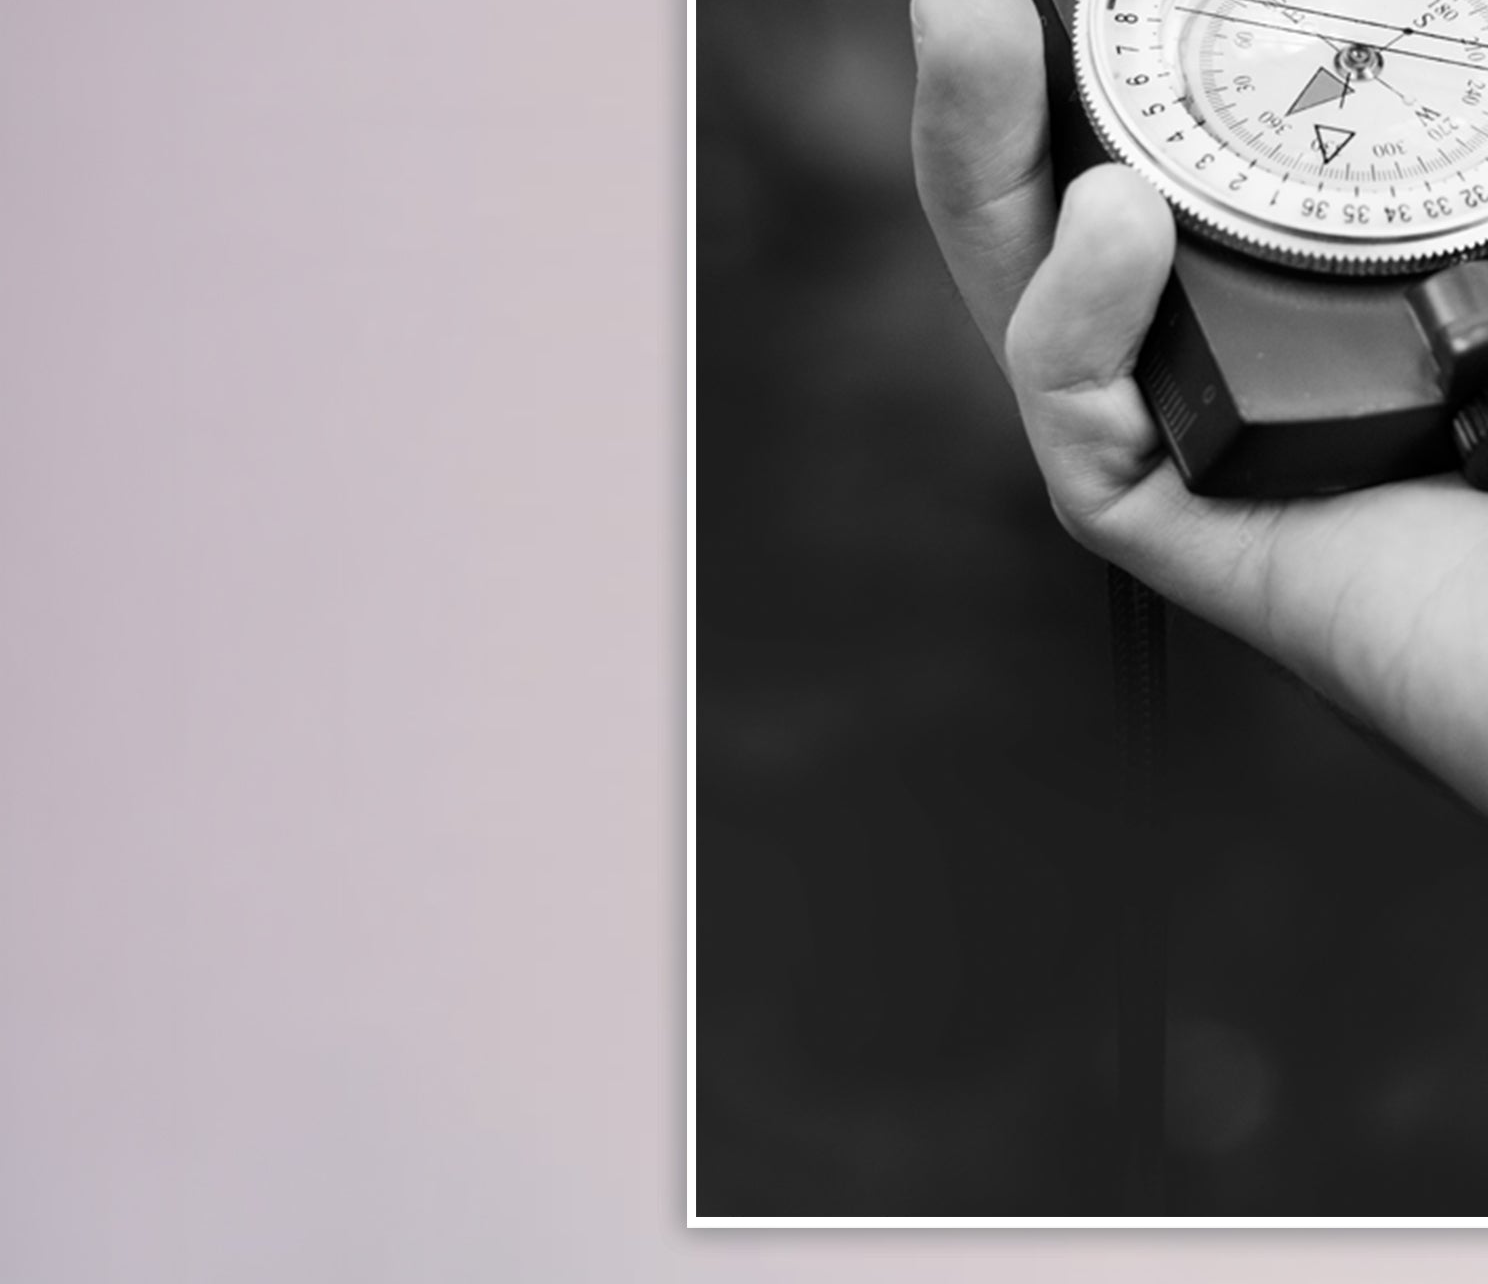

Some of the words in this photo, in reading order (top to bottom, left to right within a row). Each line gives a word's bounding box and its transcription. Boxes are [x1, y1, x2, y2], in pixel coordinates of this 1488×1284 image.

[1114, 13, 1139, 25] 8
[1115, 44, 1140, 56] 7
[1462, 79, 1486, 106] 240
[1141, 102, 1165, 117] 5
[1414, 105, 1442, 127] W
[1165, 131, 1184, 143] 4
[1195, 153, 1216, 170] 3
[1228, 172, 1248, 192] 2
[1269, 189, 1280, 206] 1
[1422, 196, 1453, 219] 33
[1300, 198, 1330, 219] 36
[1342, 203, 1371, 225] 35
[1384, 203, 1411, 223] 34
